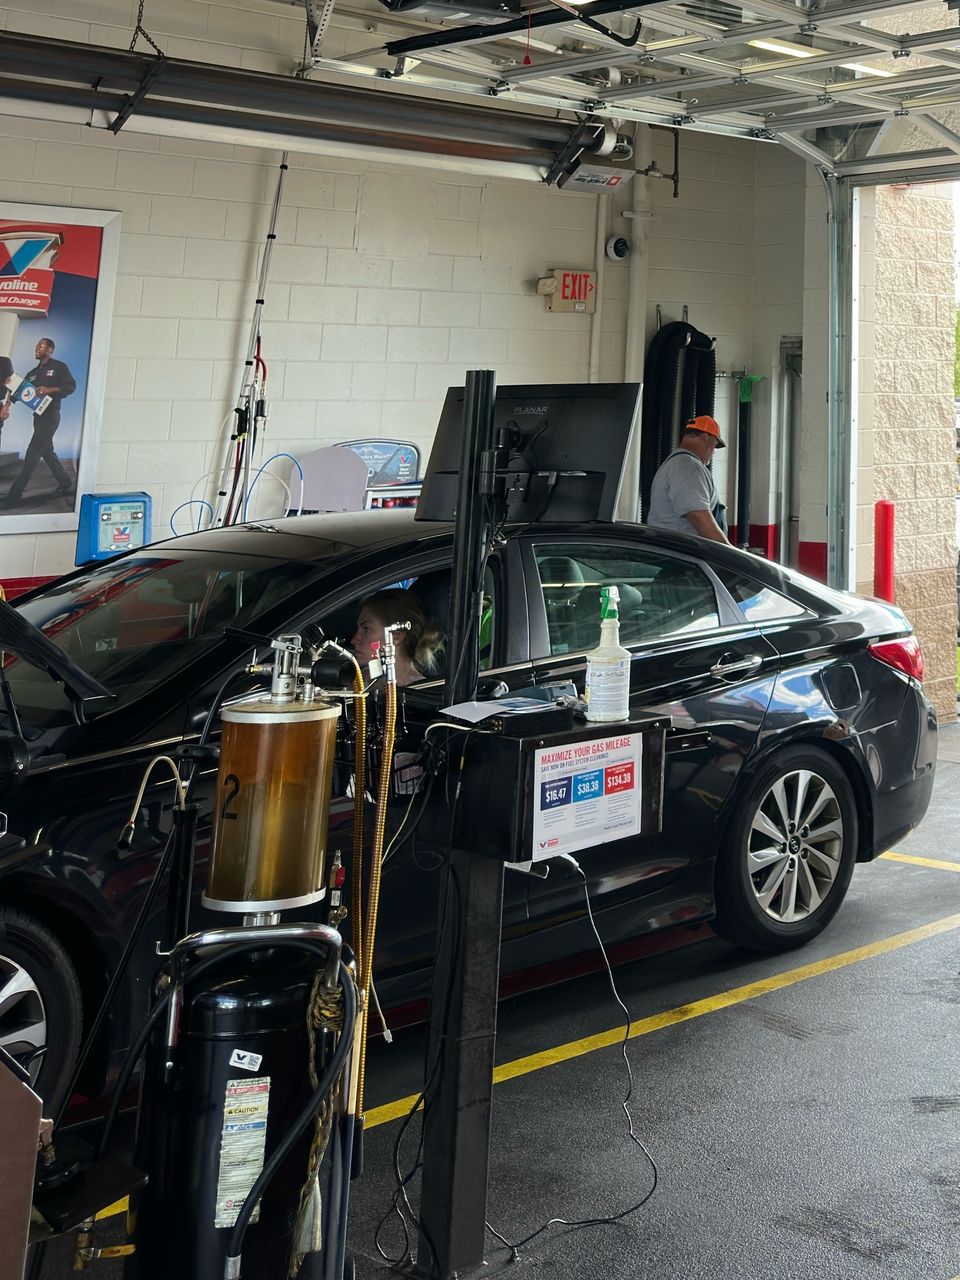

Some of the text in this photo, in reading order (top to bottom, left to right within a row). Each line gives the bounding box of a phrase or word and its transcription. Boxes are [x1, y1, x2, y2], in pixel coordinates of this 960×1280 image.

[562, 272, 590, 300] EXIT
[8, 296, 40, 306] Change
[513, 406, 548, 414] PLANAR
[541, 737, 631, 766] MAXIMIZE YOUR GAS MILEAGE
[541, 765, 550, 773] SAVE
[550, 763, 559, 771] NOW
[575, 757, 590, 765] SYSTEM
[577, 780, 599, 796] $38.38
[607, 772, 632, 788] $134.38
[222, 773, 240, 820] 2
[545, 787, 567, 803] $16.47
